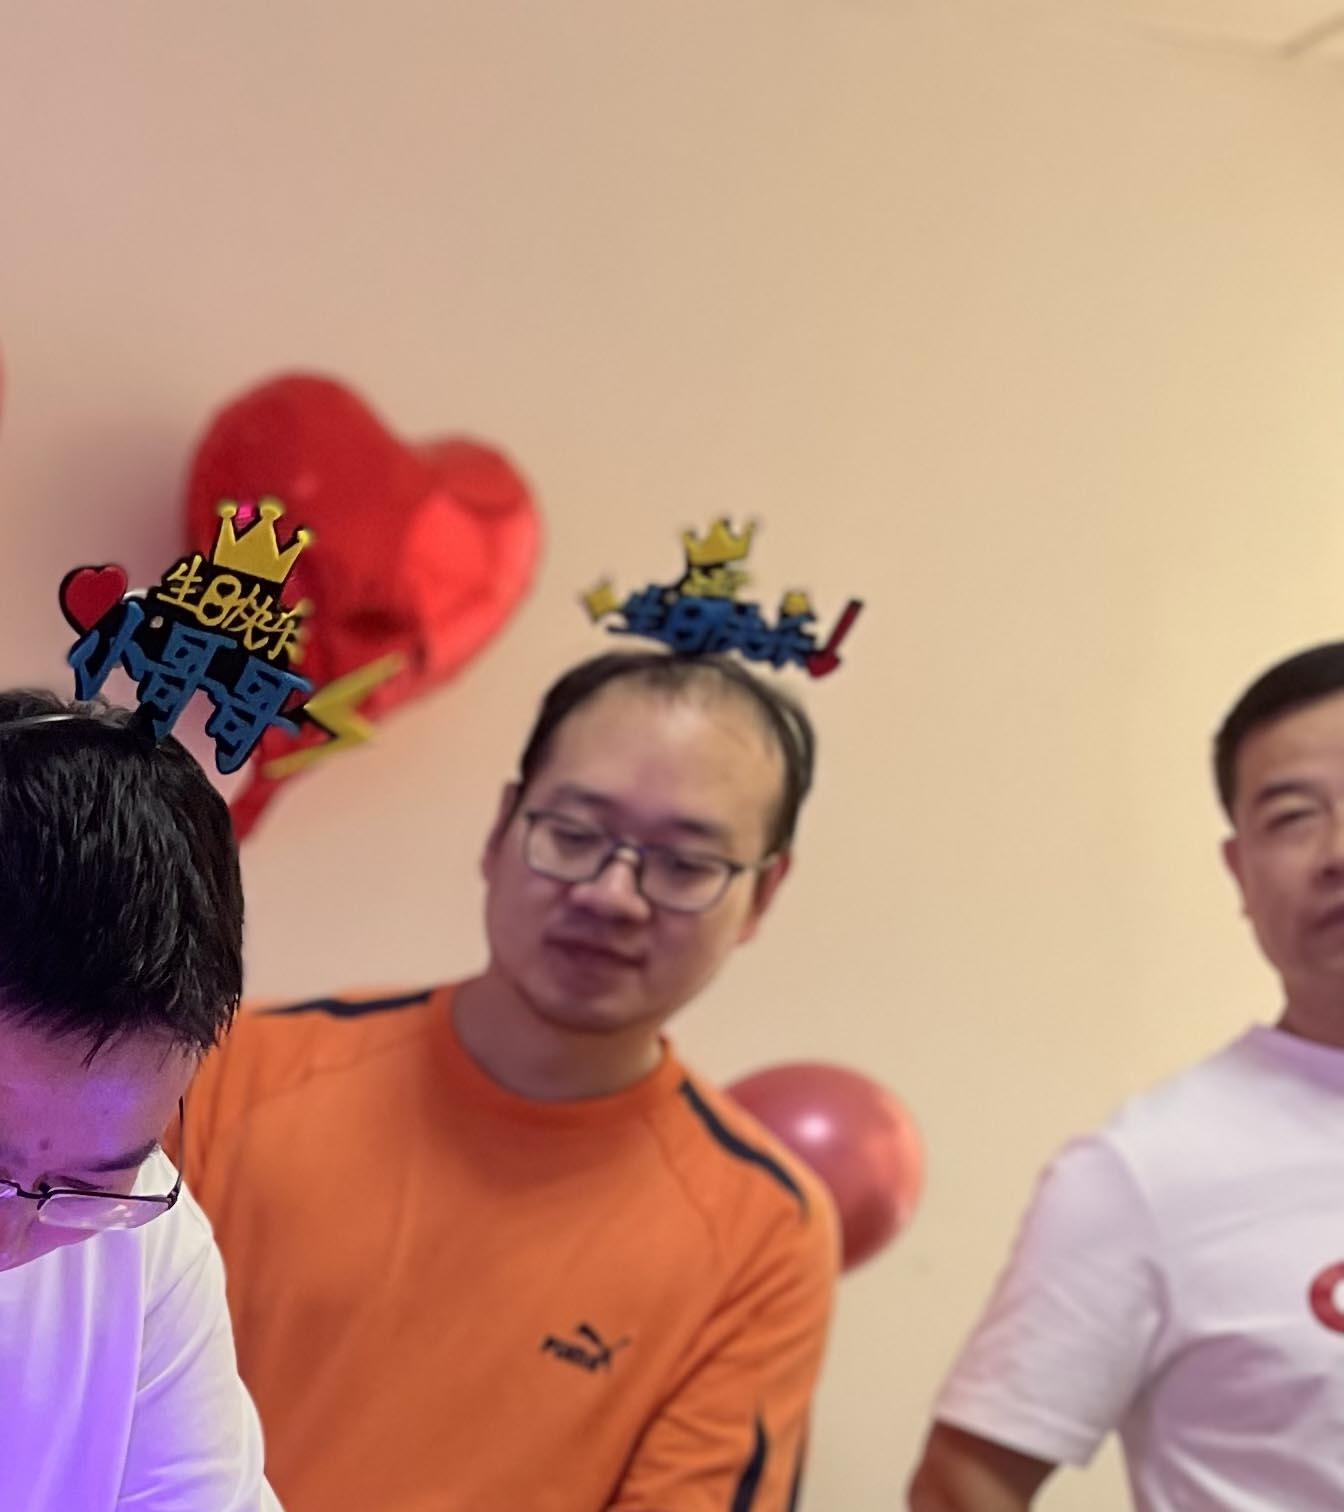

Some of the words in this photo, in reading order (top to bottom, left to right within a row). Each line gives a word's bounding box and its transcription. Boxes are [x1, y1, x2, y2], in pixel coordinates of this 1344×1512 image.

[156, 554, 306, 662] 生日快乐
[68, 601, 315, 775] 小哥哥
